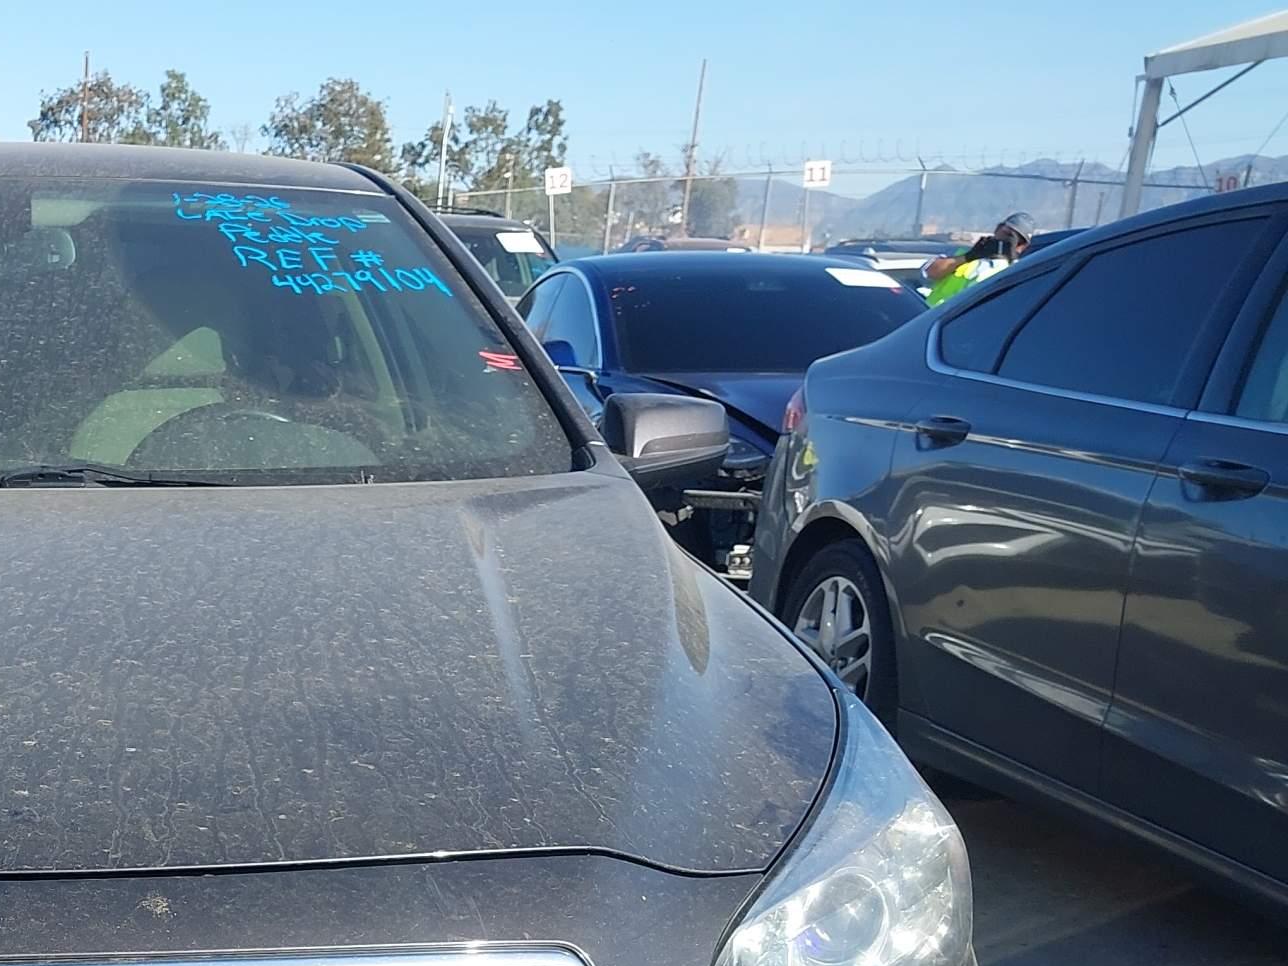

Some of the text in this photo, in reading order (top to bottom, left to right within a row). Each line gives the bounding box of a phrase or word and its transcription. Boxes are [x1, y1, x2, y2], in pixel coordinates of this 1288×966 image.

[548, 173, 569, 190] 12
[806, 167, 827, 182] 11
[1215, 175, 1238, 192] 10
[233, 246, 385, 271] REF #
[271, 267, 455, 297] 44279104
